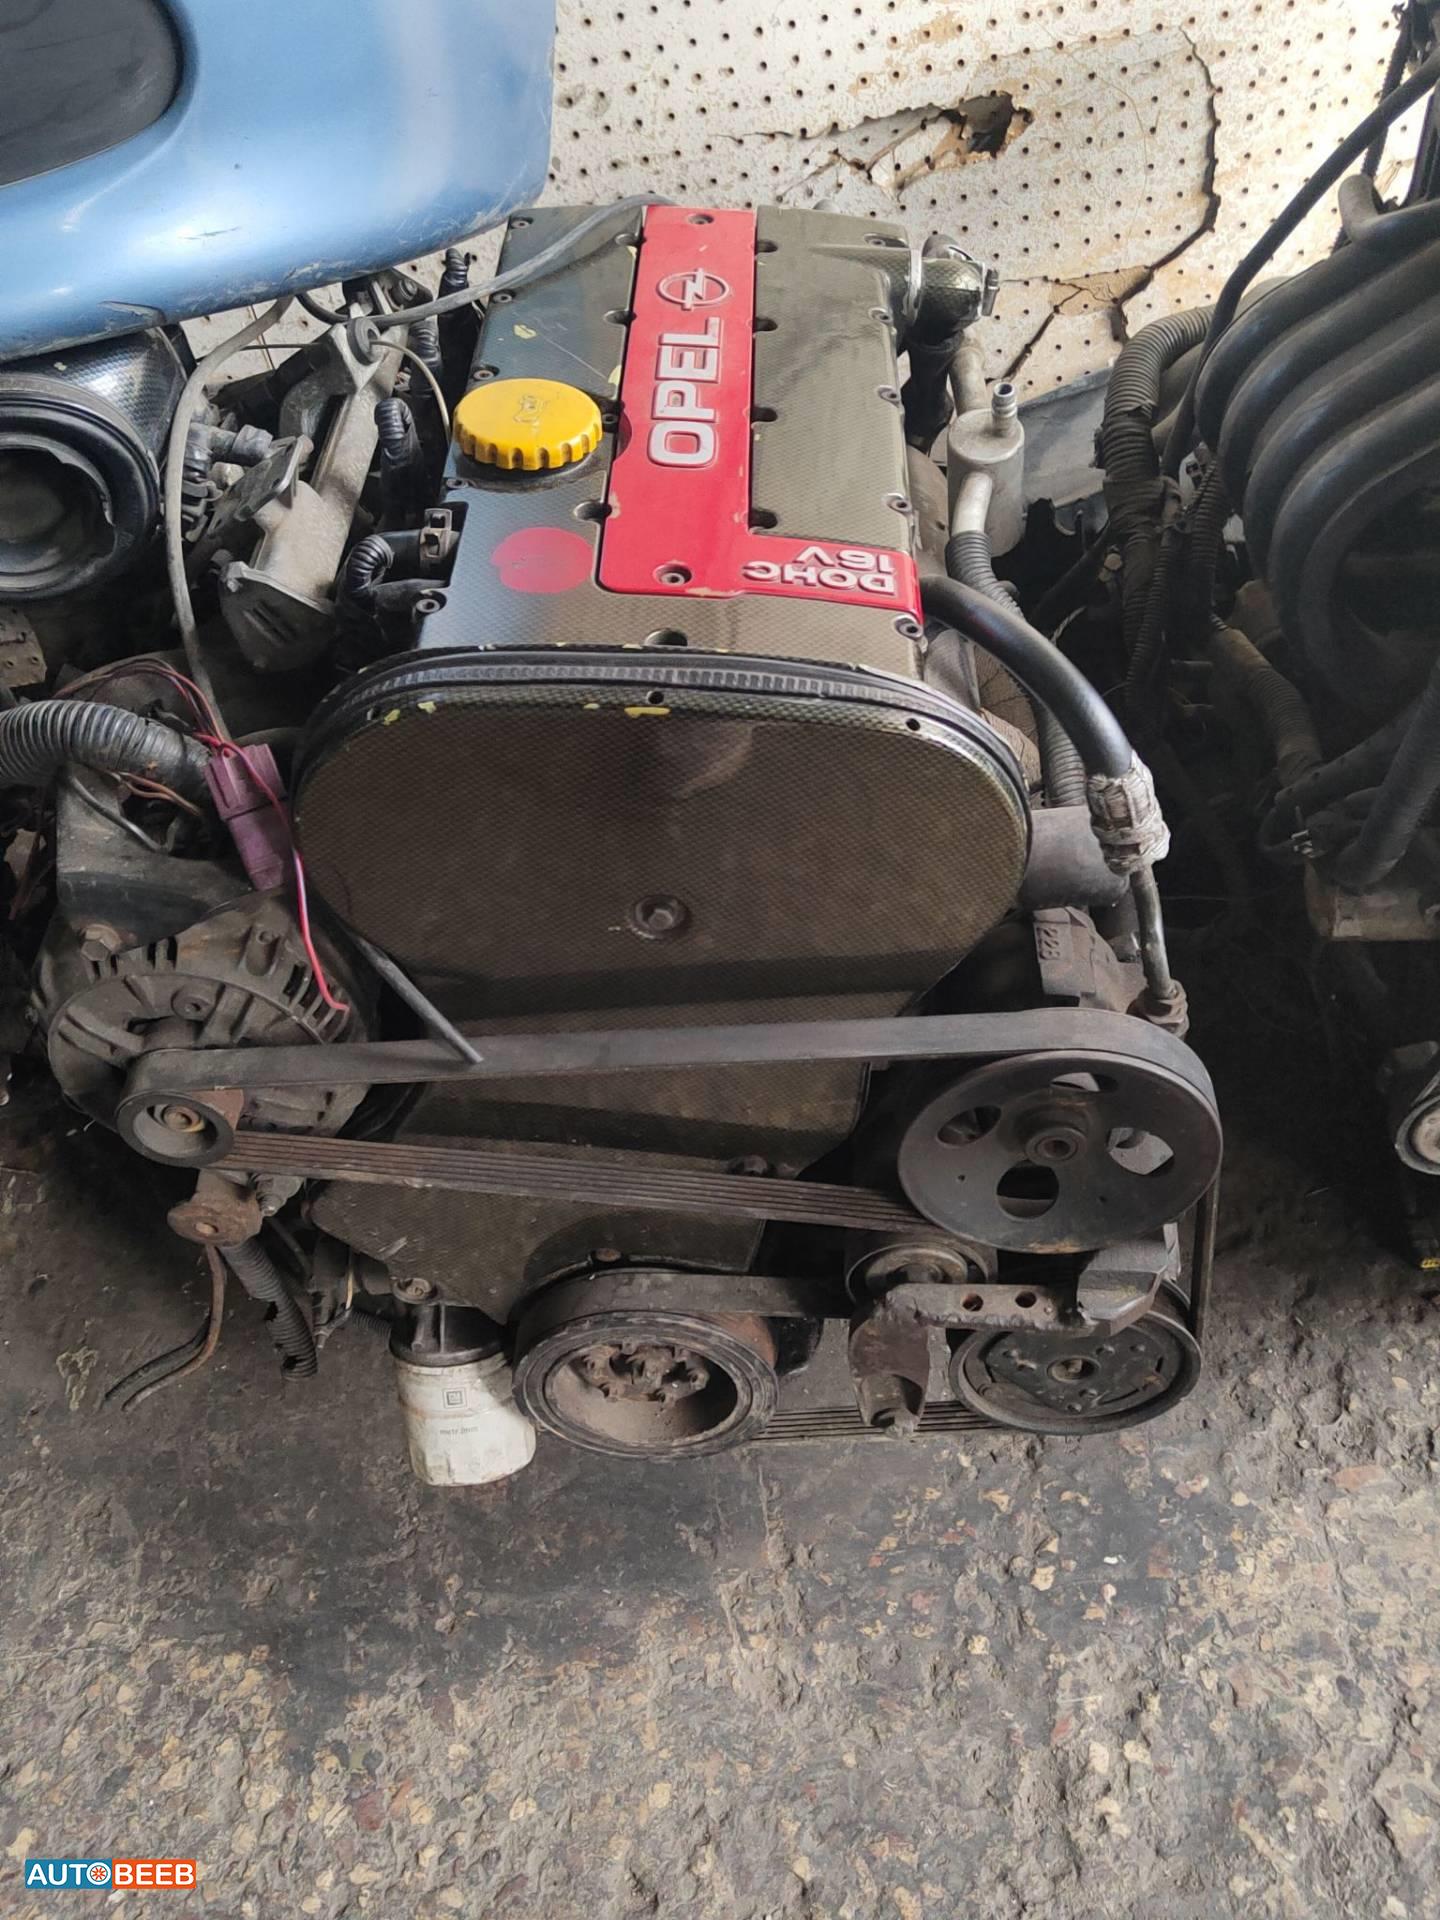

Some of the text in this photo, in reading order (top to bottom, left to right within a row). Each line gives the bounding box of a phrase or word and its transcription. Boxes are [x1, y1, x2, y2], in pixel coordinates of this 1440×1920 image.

[647, 316, 721, 467] OPEL
[793, 546, 895, 573] 16V
[743, 561, 895, 595] DOHC
